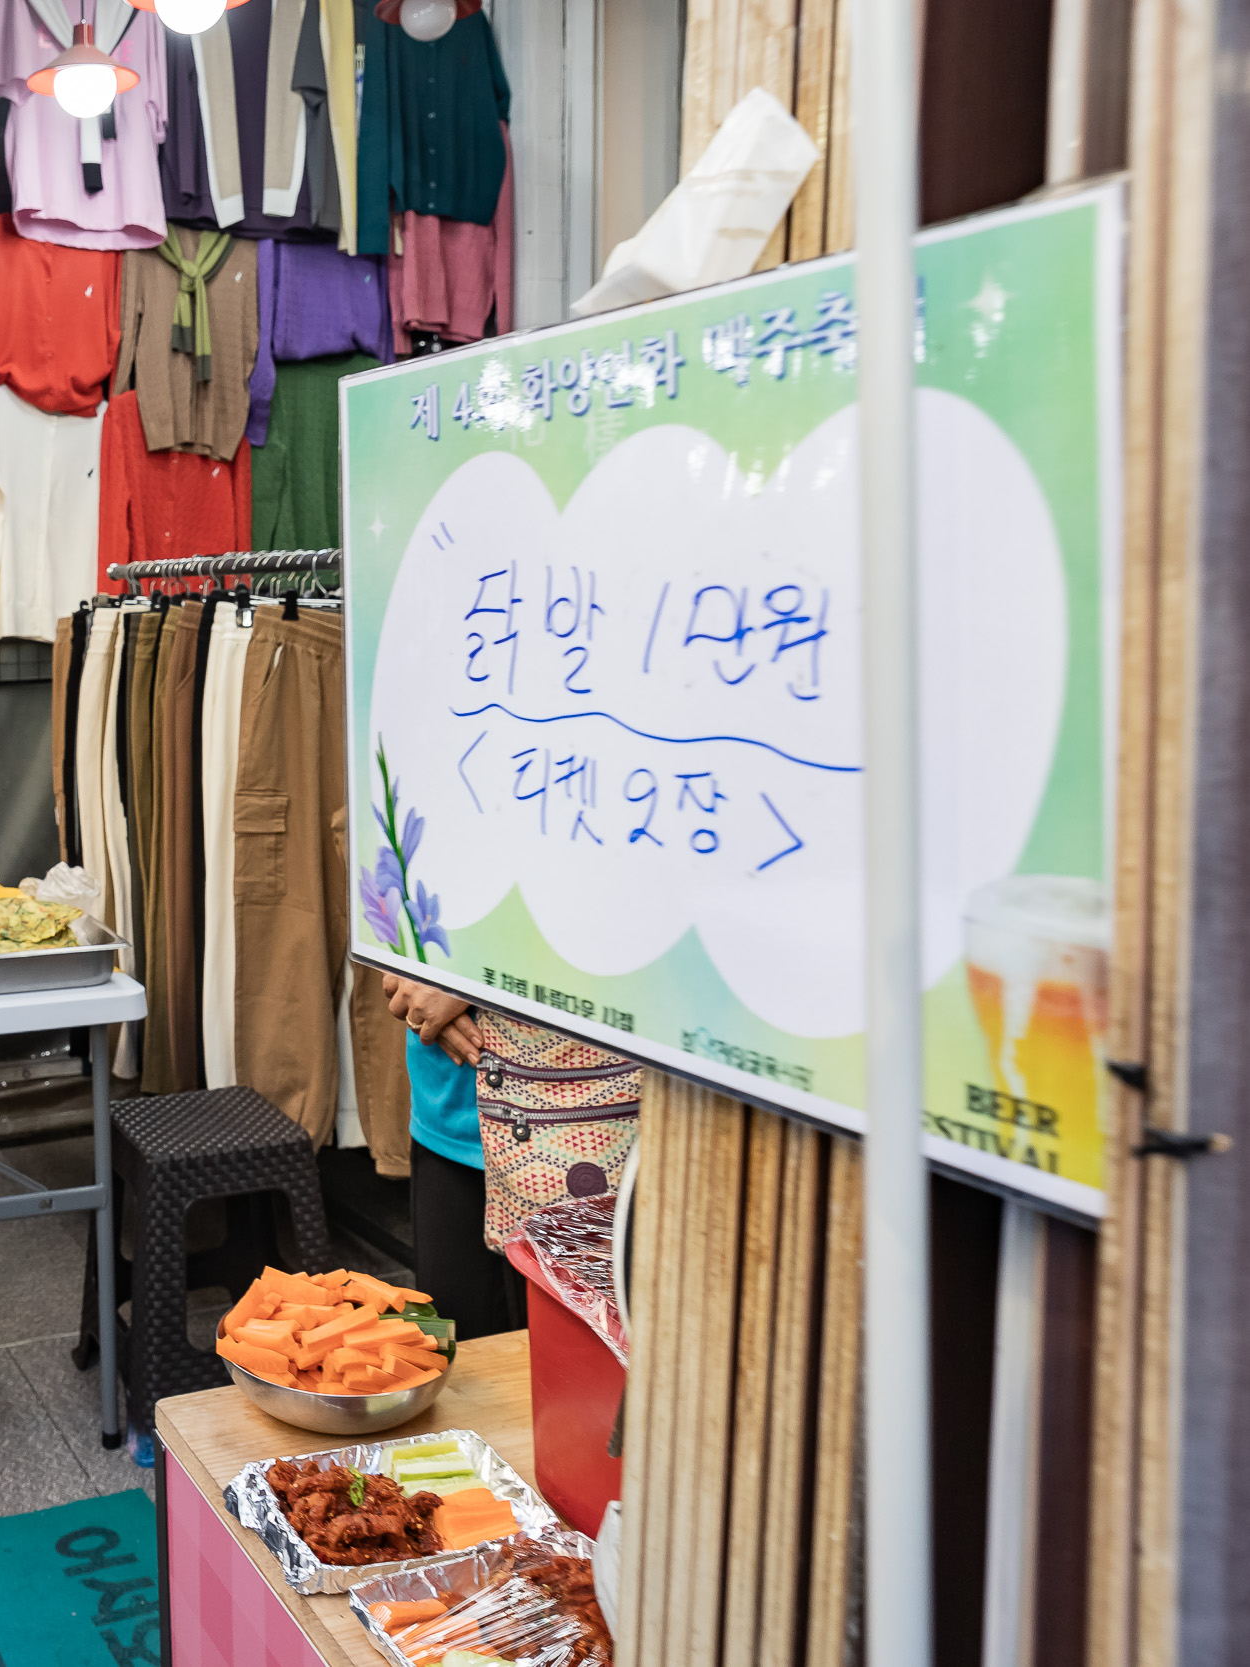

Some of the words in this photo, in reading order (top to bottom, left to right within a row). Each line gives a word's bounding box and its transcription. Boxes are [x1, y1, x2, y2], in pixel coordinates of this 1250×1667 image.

[410, 383, 440, 441] 제
[452, 356, 514, 432] 4
[521, 329, 686, 421] 화양연화
[702, 275, 926, 387] 맥주축
[966, 1083, 1059, 1138] BEER
